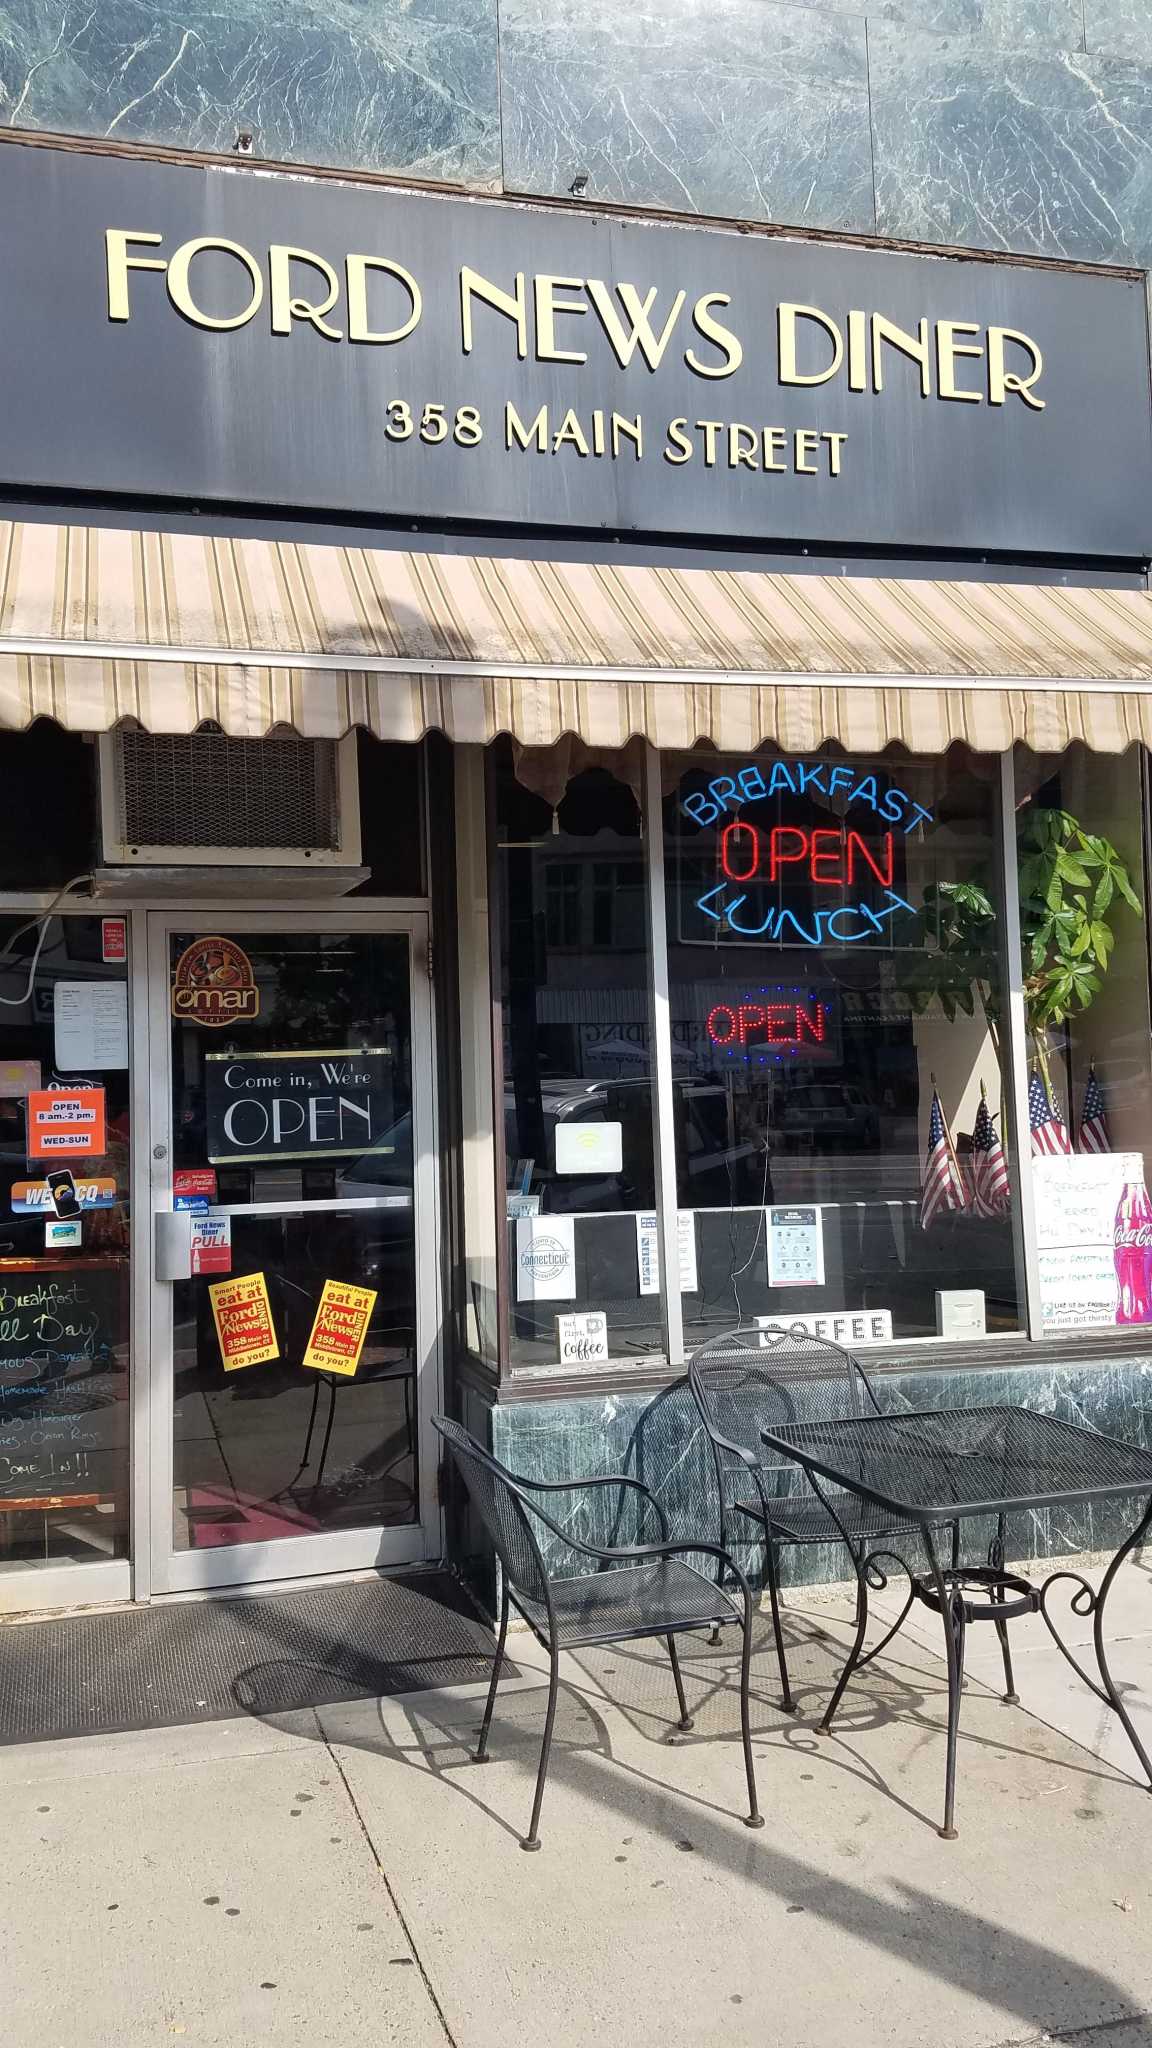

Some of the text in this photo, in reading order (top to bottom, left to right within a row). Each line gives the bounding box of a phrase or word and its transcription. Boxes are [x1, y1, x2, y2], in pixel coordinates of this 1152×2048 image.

[105, 228, 1046, 411] FORD NEWS DINER
[384, 399, 849, 478] 358 MAIN STREET
[683, 761, 934, 835] BREAKFAST
[721, 821, 895, 887] OPEN
[696, 881, 918, 945] LUNCH
[175, 989, 255, 1009] omar
[706, 1002, 826, 1044] OPEN
[224, 1062, 373, 1089] Come in, We're
[52, 1103, 80, 1111] OPEN
[223, 1095, 372, 1146] OPEN
[43, 1136, 89, 1145] WED-SUN
[193, 1221, 226, 1230] Ford News
[192, 1235, 229, 1248] PULL
[520, 1251, 569, 1266] Connecticut
[214, 1279, 261, 1295] Smart People
[217, 1285, 263, 1306] eat at
[328, 1281, 354, 1292] Beautiful
[327, 1291, 370, 1309] eat at
[220, 1303, 258, 1325] Ford
[256, 1300, 270, 1331] DINER
[320, 1304, 359, 1325] Ford
[1057, 1316, 1072, 1325] just
[1073, 1315, 1087, 1323] got
[1088, 1314, 1113, 1322] thirsty
[33, 1311, 100, 1352] Day
[222, 1319, 260, 1336] News
[317, 1317, 354, 1336] News
[350, 1313, 366, 1342] DINER
[763, 1316, 884, 1345] COFFEE
[226, 1336, 248, 1348] 358
[315, 1334, 336, 1345] 358
[564, 1338, 604, 1361] Coffee
[232, 1348, 270, 1366] do you?
[312, 1353, 350, 1368] do you?
